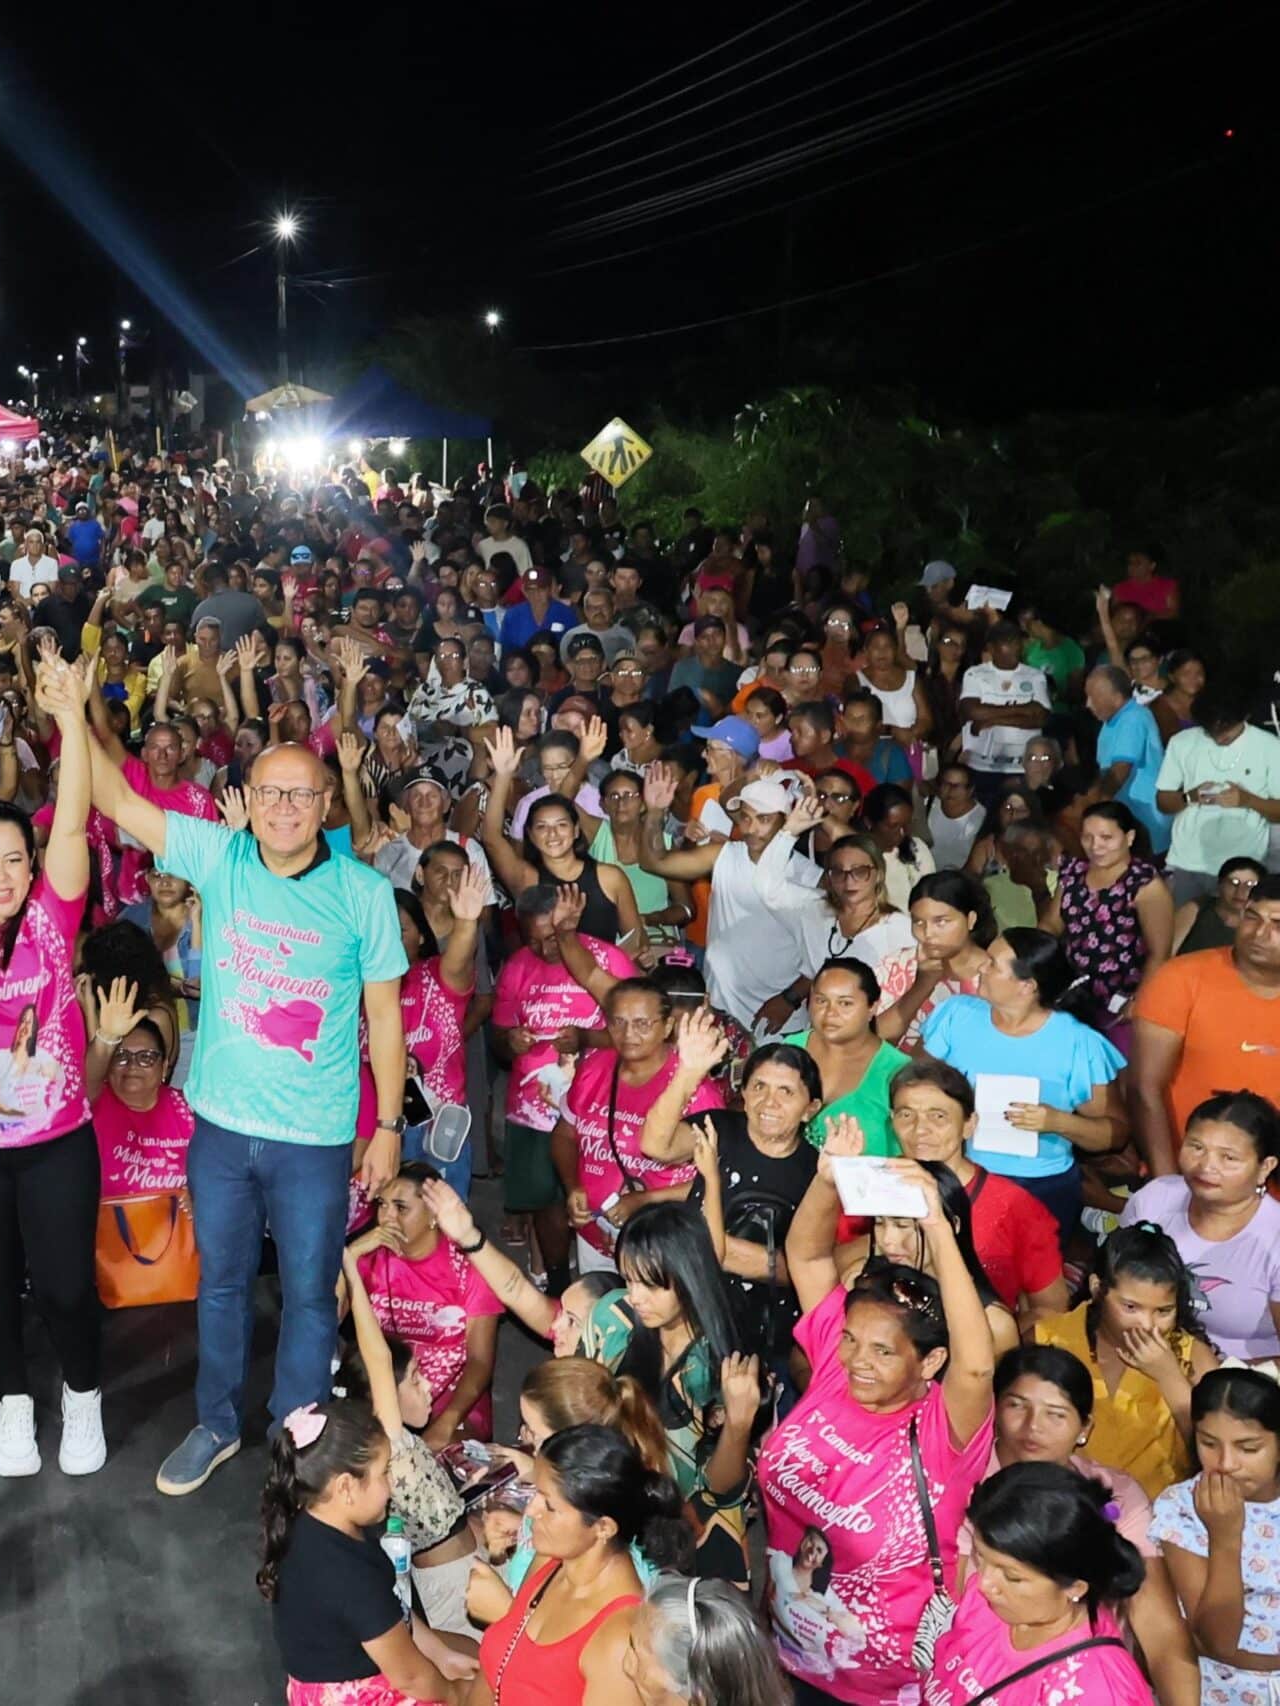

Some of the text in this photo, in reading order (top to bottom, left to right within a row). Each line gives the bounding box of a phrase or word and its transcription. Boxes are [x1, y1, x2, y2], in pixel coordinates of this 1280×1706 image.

[231, 951, 332, 1000] Movimento
[112, 1145, 167, 1168] Mulheres
[124, 1164, 188, 1189] Movim
[767, 1448, 877, 1534] Movimento
